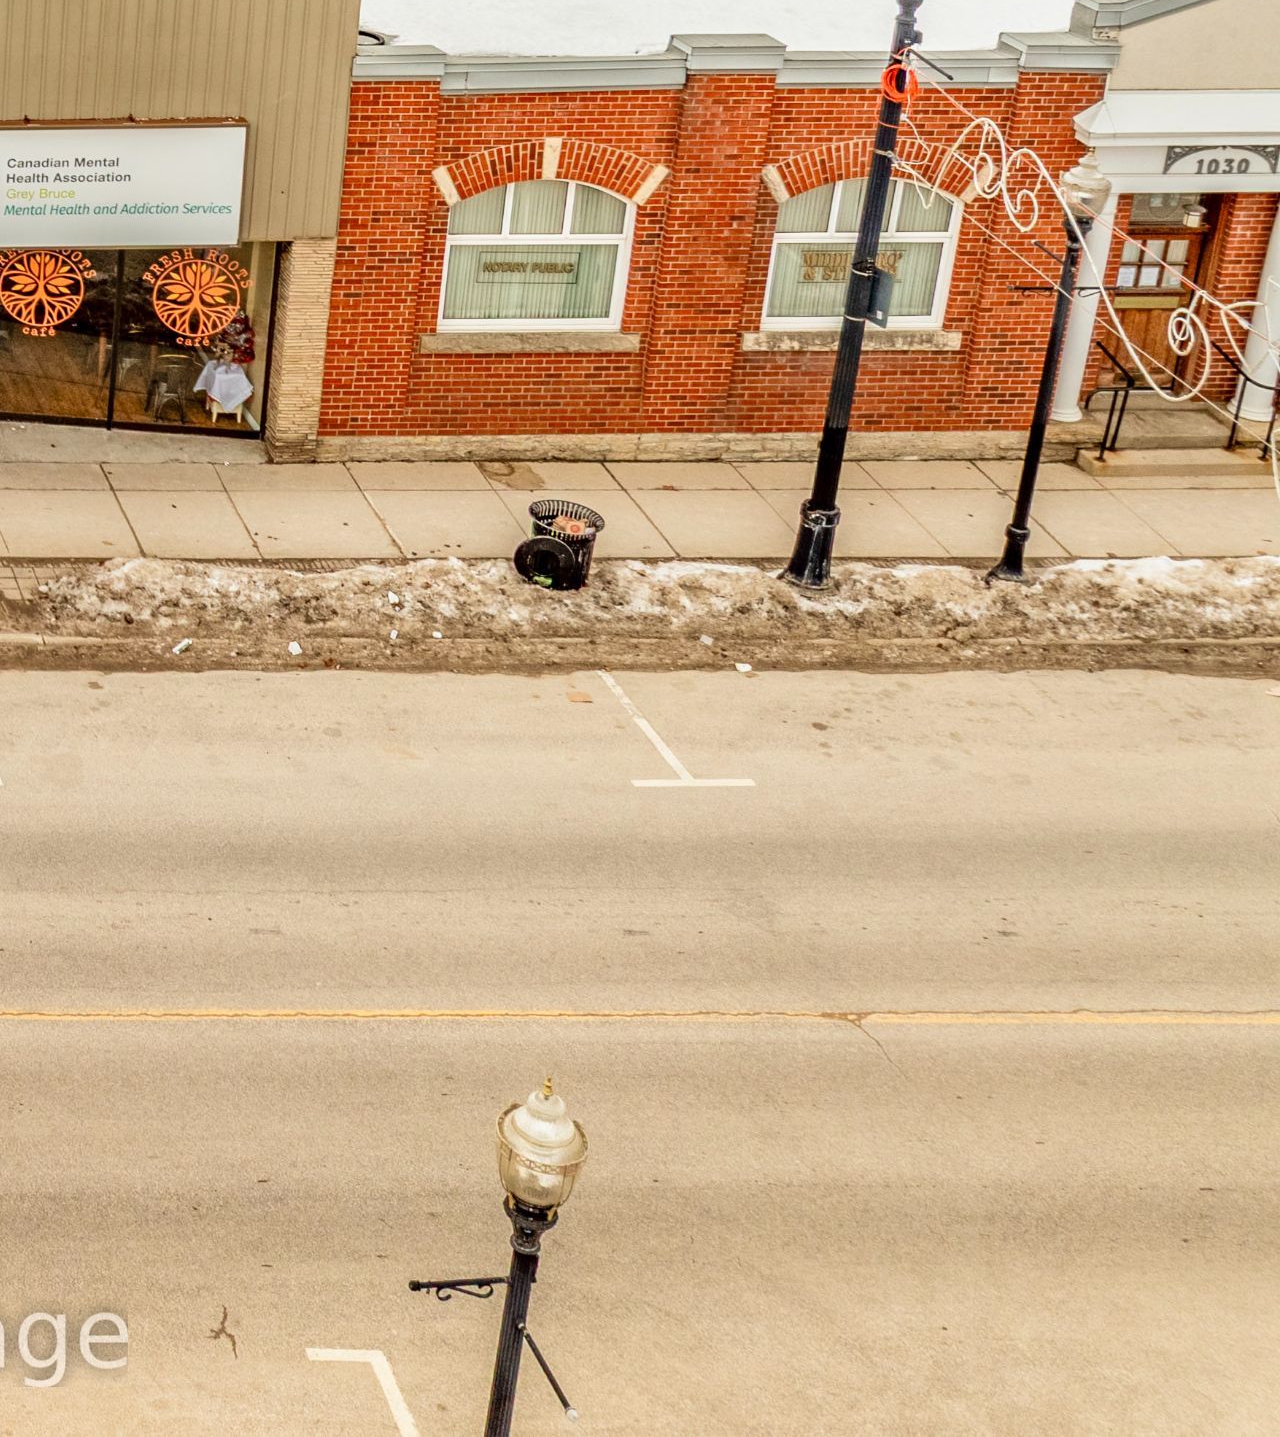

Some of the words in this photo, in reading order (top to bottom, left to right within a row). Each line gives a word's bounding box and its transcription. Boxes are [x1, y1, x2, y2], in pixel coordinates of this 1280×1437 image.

[7, 158, 70, 169] Canadian
[74, 157, 120, 168] Mental
[1194, 158, 1250, 174] 1030
[6, 173, 49, 183] Health
[53, 172, 131, 183] Association
[6, 188, 34, 201] Grey
[39, 188, 76, 199] Bruce
[4, 204, 47, 216] Mental
[49, 204, 91, 215] Health
[93, 204, 117, 215] and
[120, 203, 179, 215] Addiction
[182, 203, 232, 214] Services
[142, 248, 194, 284] FRESH
[207, 249, 255, 289] ROOTS
[483, 261, 529, 273] NOTARY
[531, 262, 575, 273] PUBLIC
[22, 326, 56, 337] café
[176, 336, 210, 347] café
